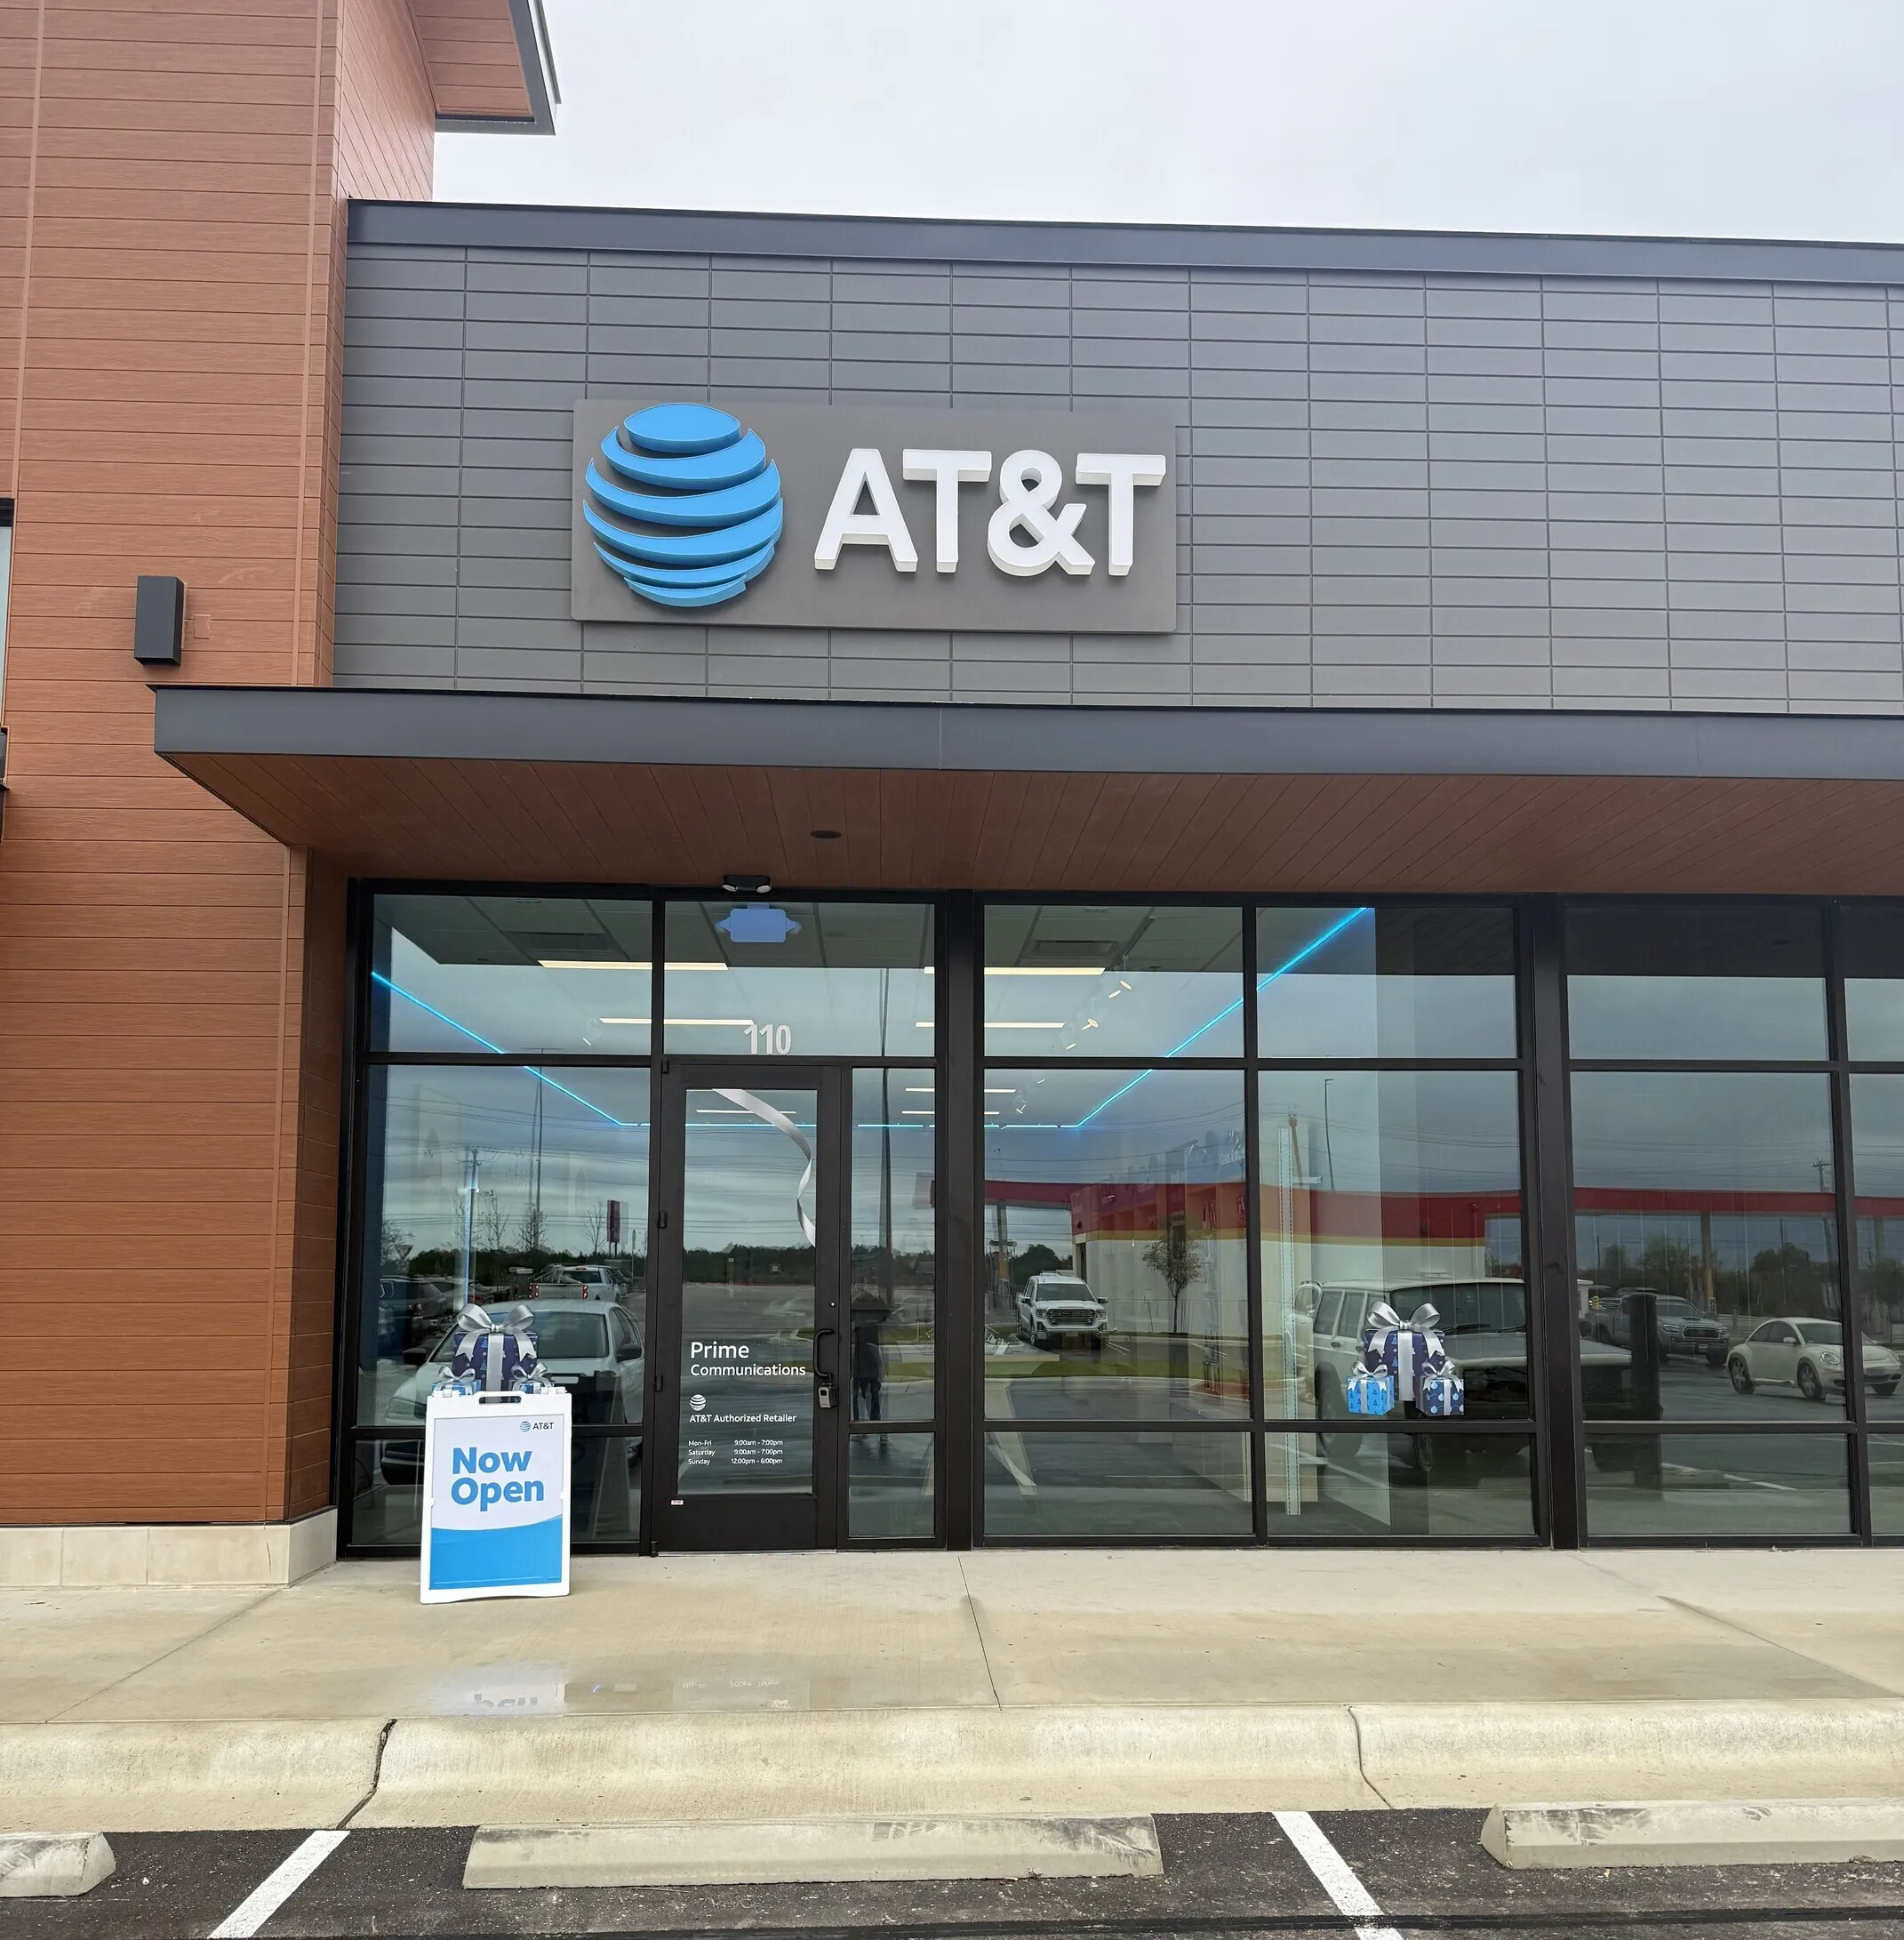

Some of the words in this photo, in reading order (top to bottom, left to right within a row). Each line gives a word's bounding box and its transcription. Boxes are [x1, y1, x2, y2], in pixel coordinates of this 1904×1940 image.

[814, 448, 1165, 576] AT&T
[743, 1024, 791, 1055] 110
[691, 1341, 749, 1359] Prime
[691, 1364, 806, 1376] Communications
[532, 1422, 555, 1431] AT&T
[690, 1415, 712, 1423] AT&T
[714, 1415, 761, 1423] Authorized
[764, 1415, 796, 1423] Retailer
[452, 1447, 532, 1474] Now
[451, 1477, 544, 1511] Open
